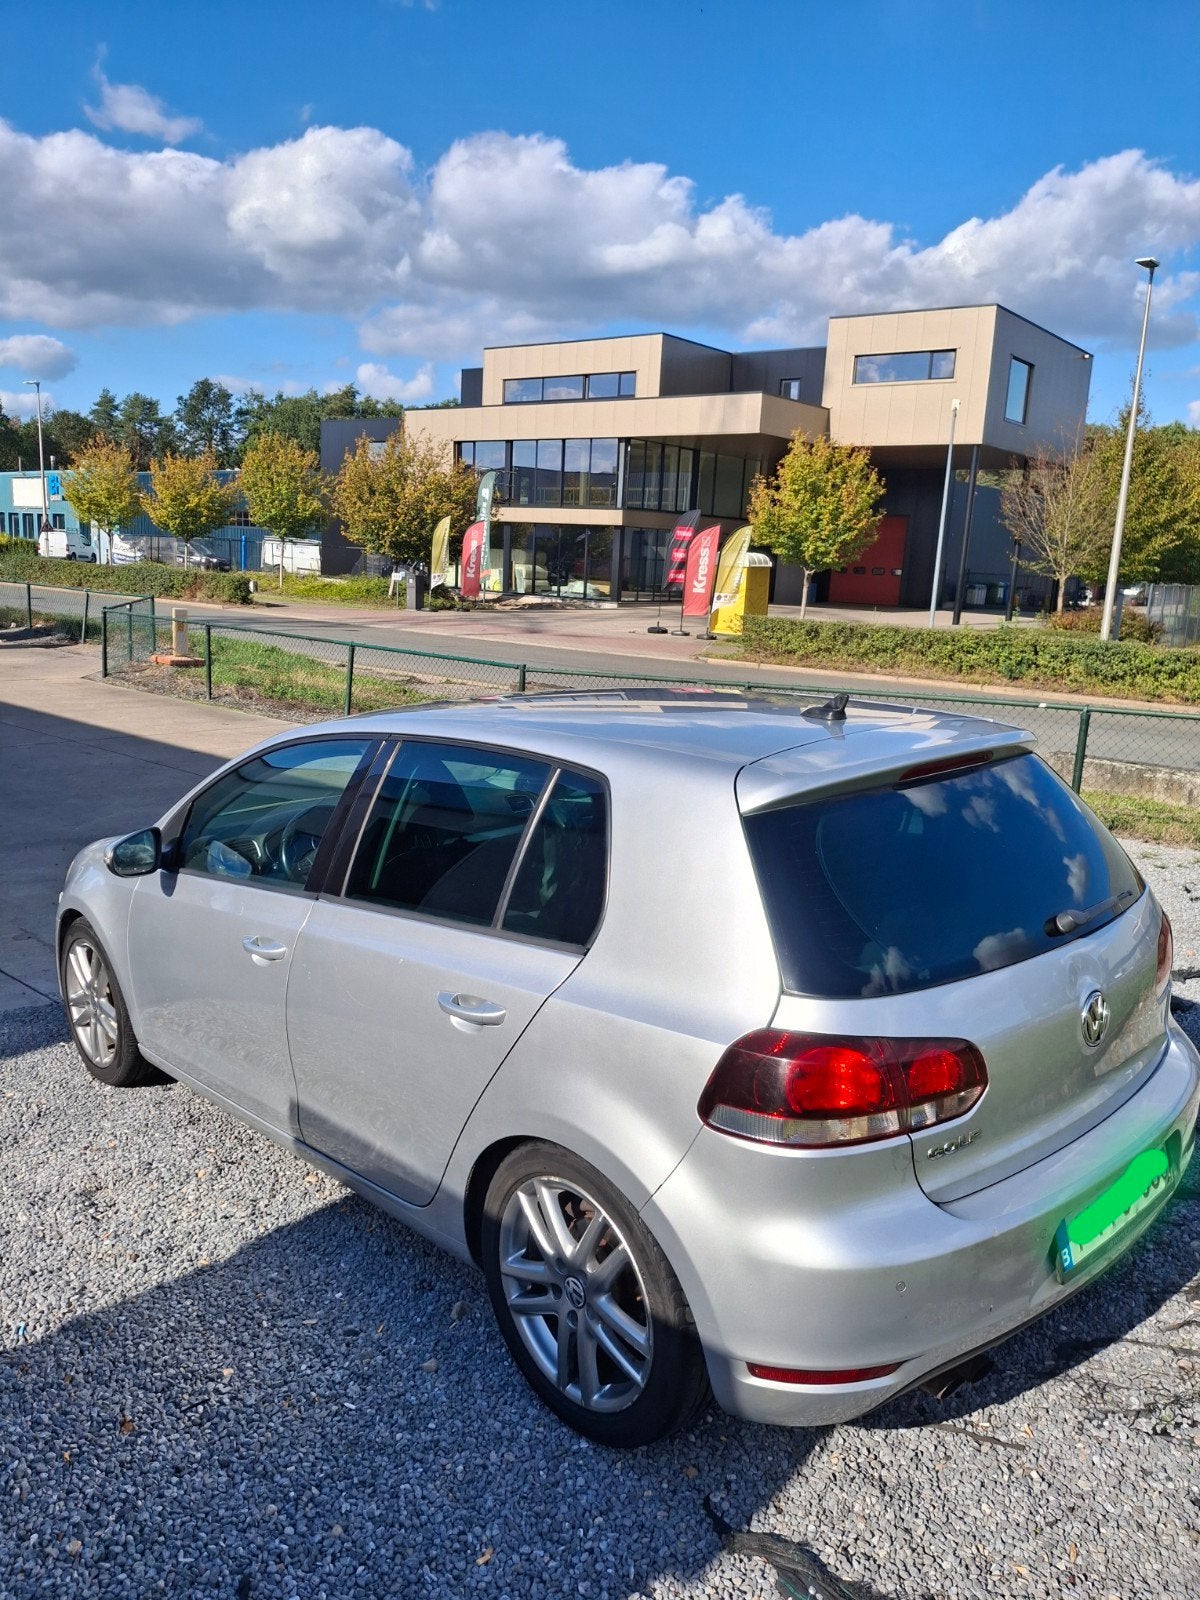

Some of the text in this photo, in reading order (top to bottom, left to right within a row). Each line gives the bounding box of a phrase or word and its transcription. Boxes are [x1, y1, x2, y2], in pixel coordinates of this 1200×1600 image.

[466, 540, 478, 578] Kress
[692, 547, 710, 593] Kress
[927, 1128, 982, 1161] GOLF
[1060, 1247, 1071, 1267] B
